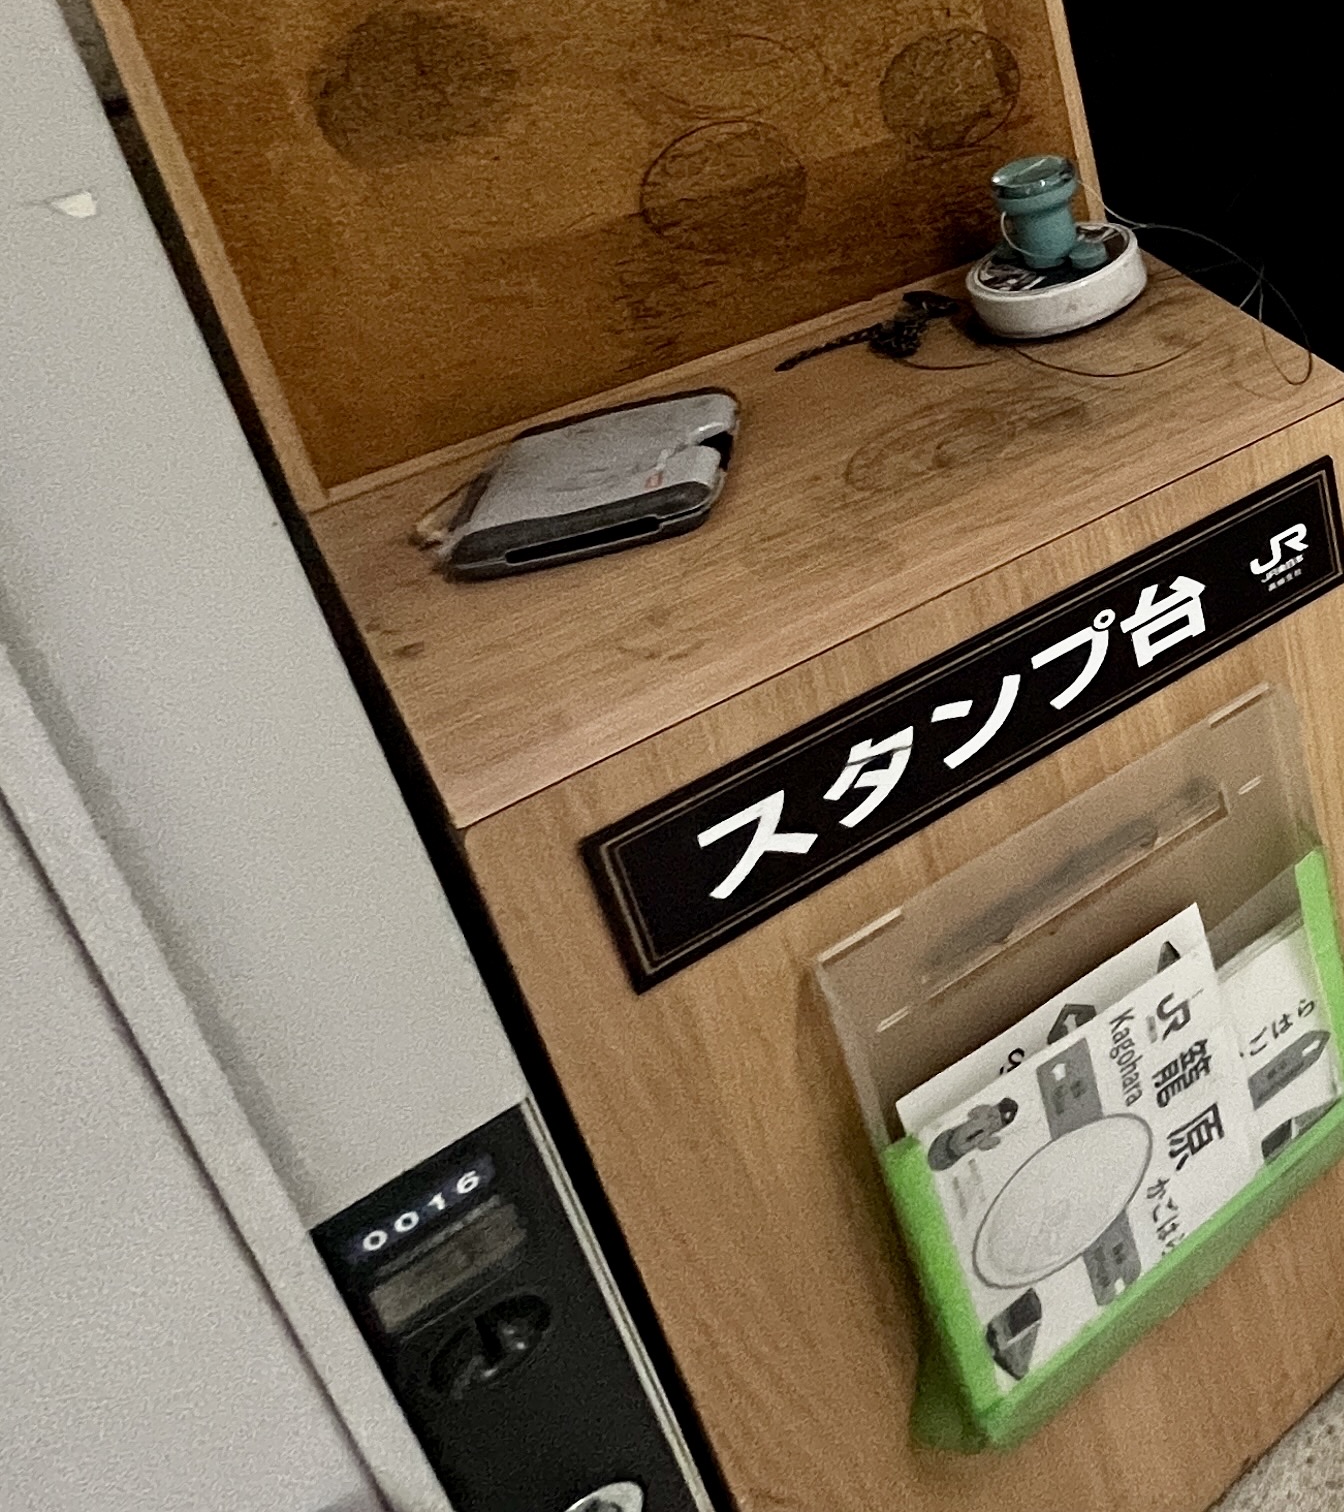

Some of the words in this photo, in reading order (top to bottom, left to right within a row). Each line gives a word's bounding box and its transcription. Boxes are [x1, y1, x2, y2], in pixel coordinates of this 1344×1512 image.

[1249, 522, 1309, 576] JR
[696, 572, 1208, 901] スタンプ台
[1109, 1007, 1145, 1108] Kagohara
[1156, 991, 1192, 1041] JR
[362, 1169, 481, 1253] 0016
